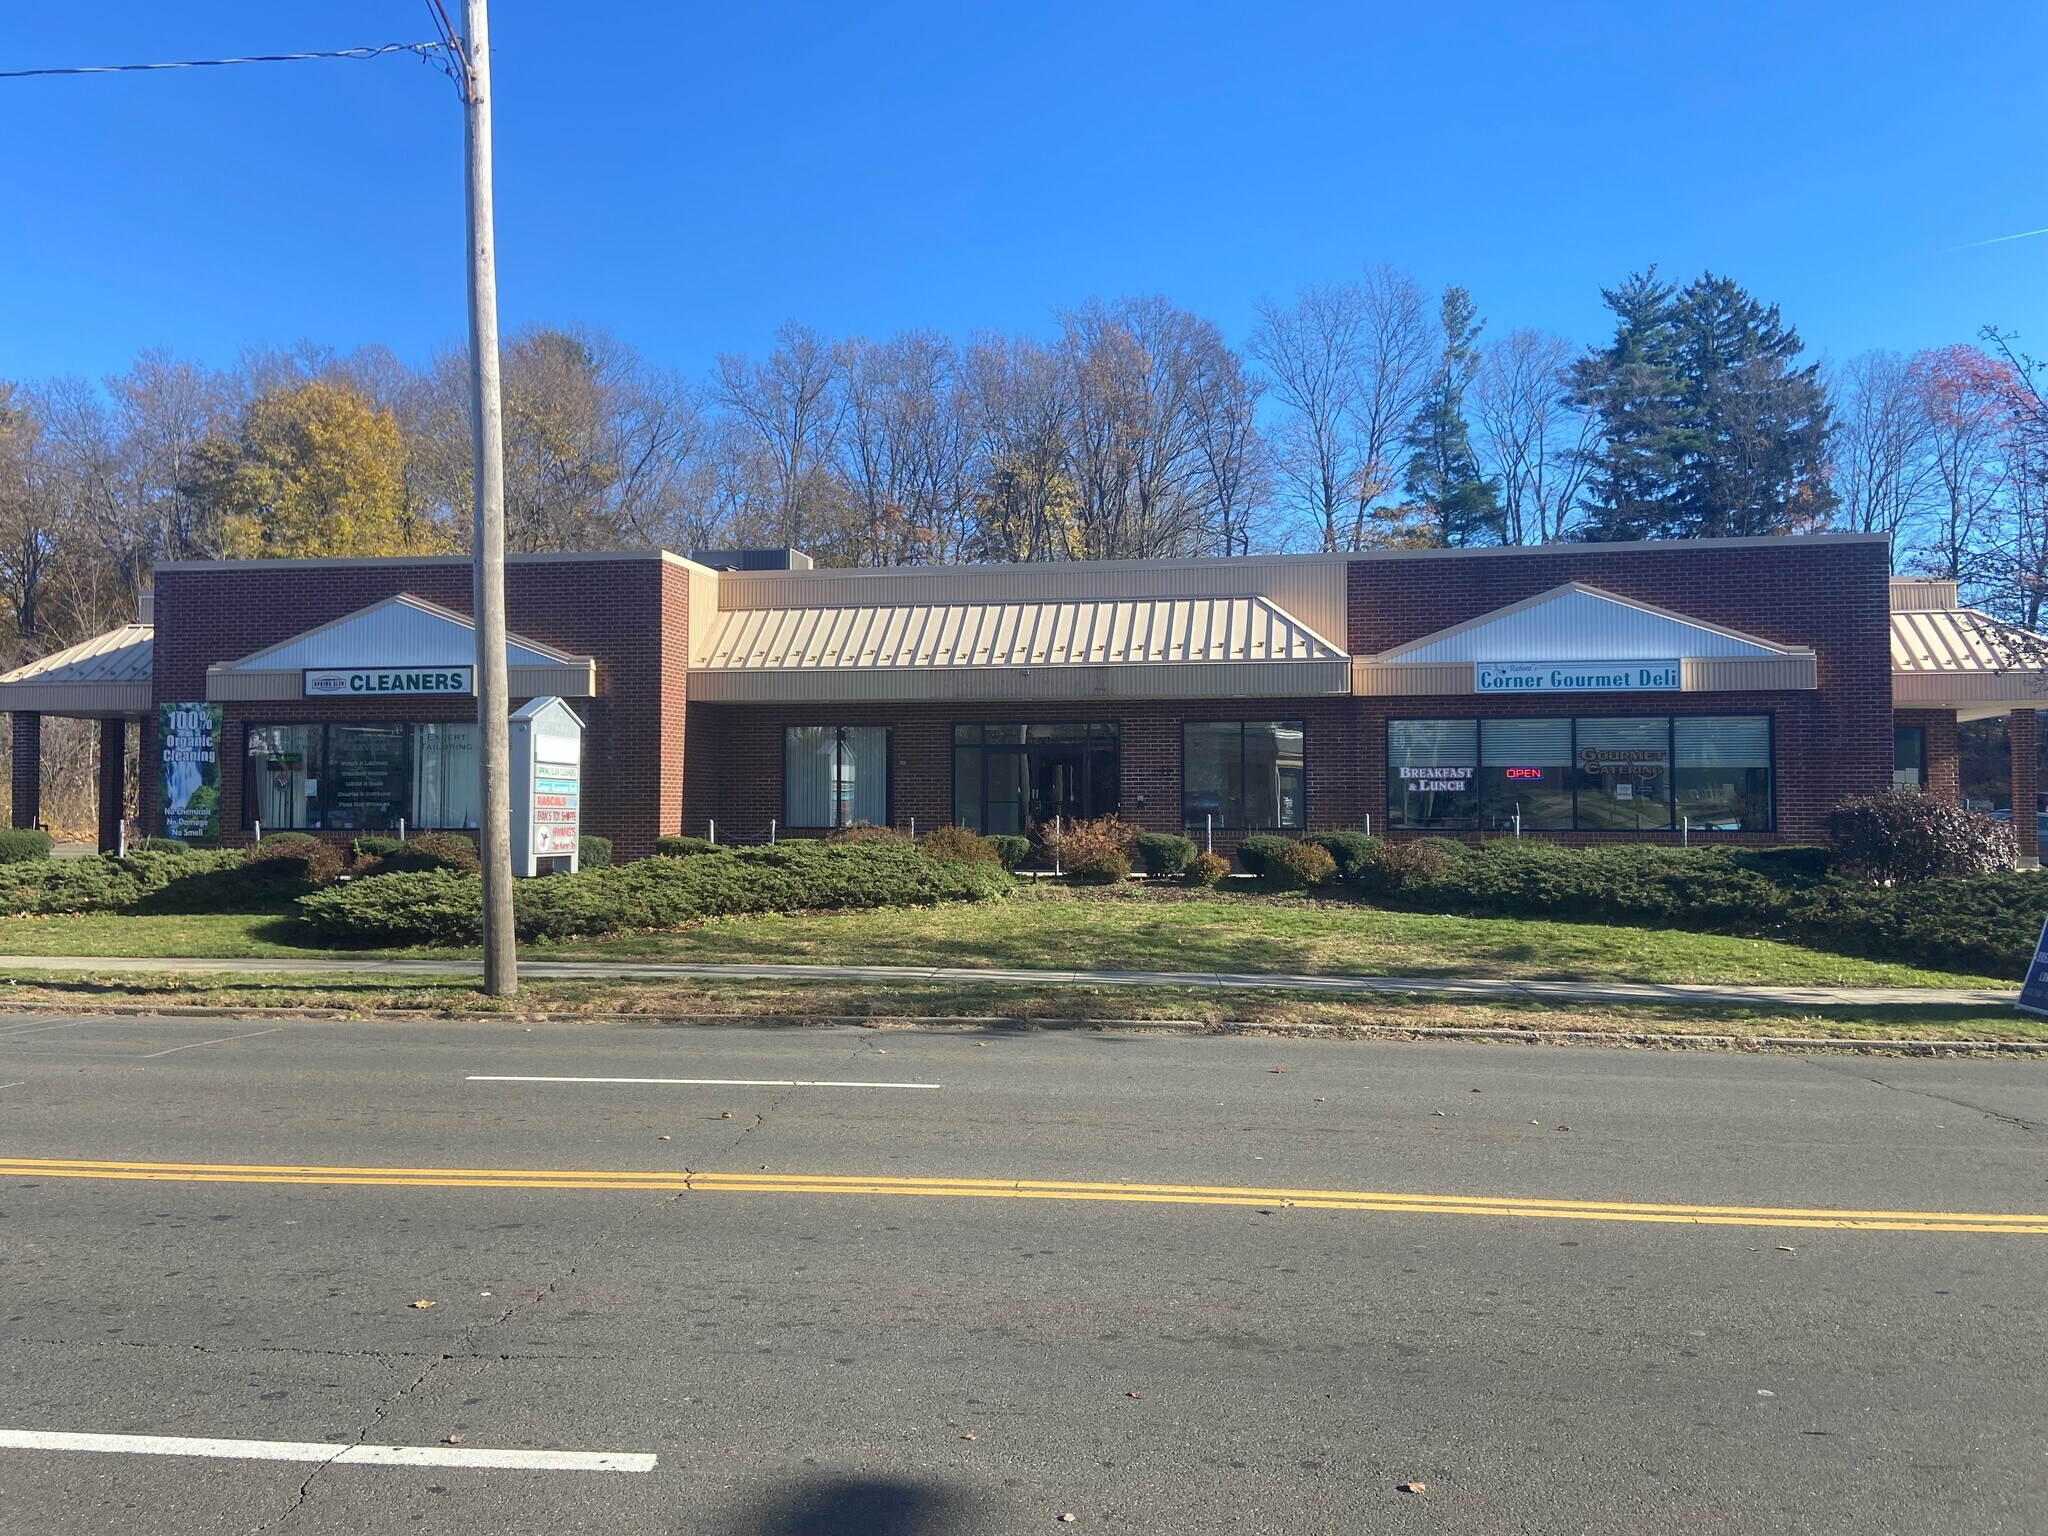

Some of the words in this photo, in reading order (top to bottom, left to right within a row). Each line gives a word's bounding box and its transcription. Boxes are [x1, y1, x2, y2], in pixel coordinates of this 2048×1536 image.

[350, 673, 463, 691] CLEANERS
[1481, 671, 1543, 688] Corner
[1551, 670, 1631, 688] Gourmet
[1639, 669, 1676, 687] Deli
[168, 711, 213, 730] 100%
[166, 734, 213, 749] Organic
[163, 749, 216, 763] Cleaning
[1581, 747, 1666, 761] GOURMET
[1399, 767, 1474, 778] BREAKFAST
[1506, 769, 1541, 778] OPEN
[1584, 761, 1664, 778] CATERING
[1408, 783, 1417, 791] &
[1419, 779, 1466, 791] LUNCH
[537, 796, 567, 806] RASCALS
[164, 807, 174, 815] No
[176, 807, 211, 816] Chemicals
[166, 818, 177, 826] No
[178, 818, 209, 828] Damage
[183, 828, 203, 836] Smell
[552, 827, 576, 837] HWANG'S
